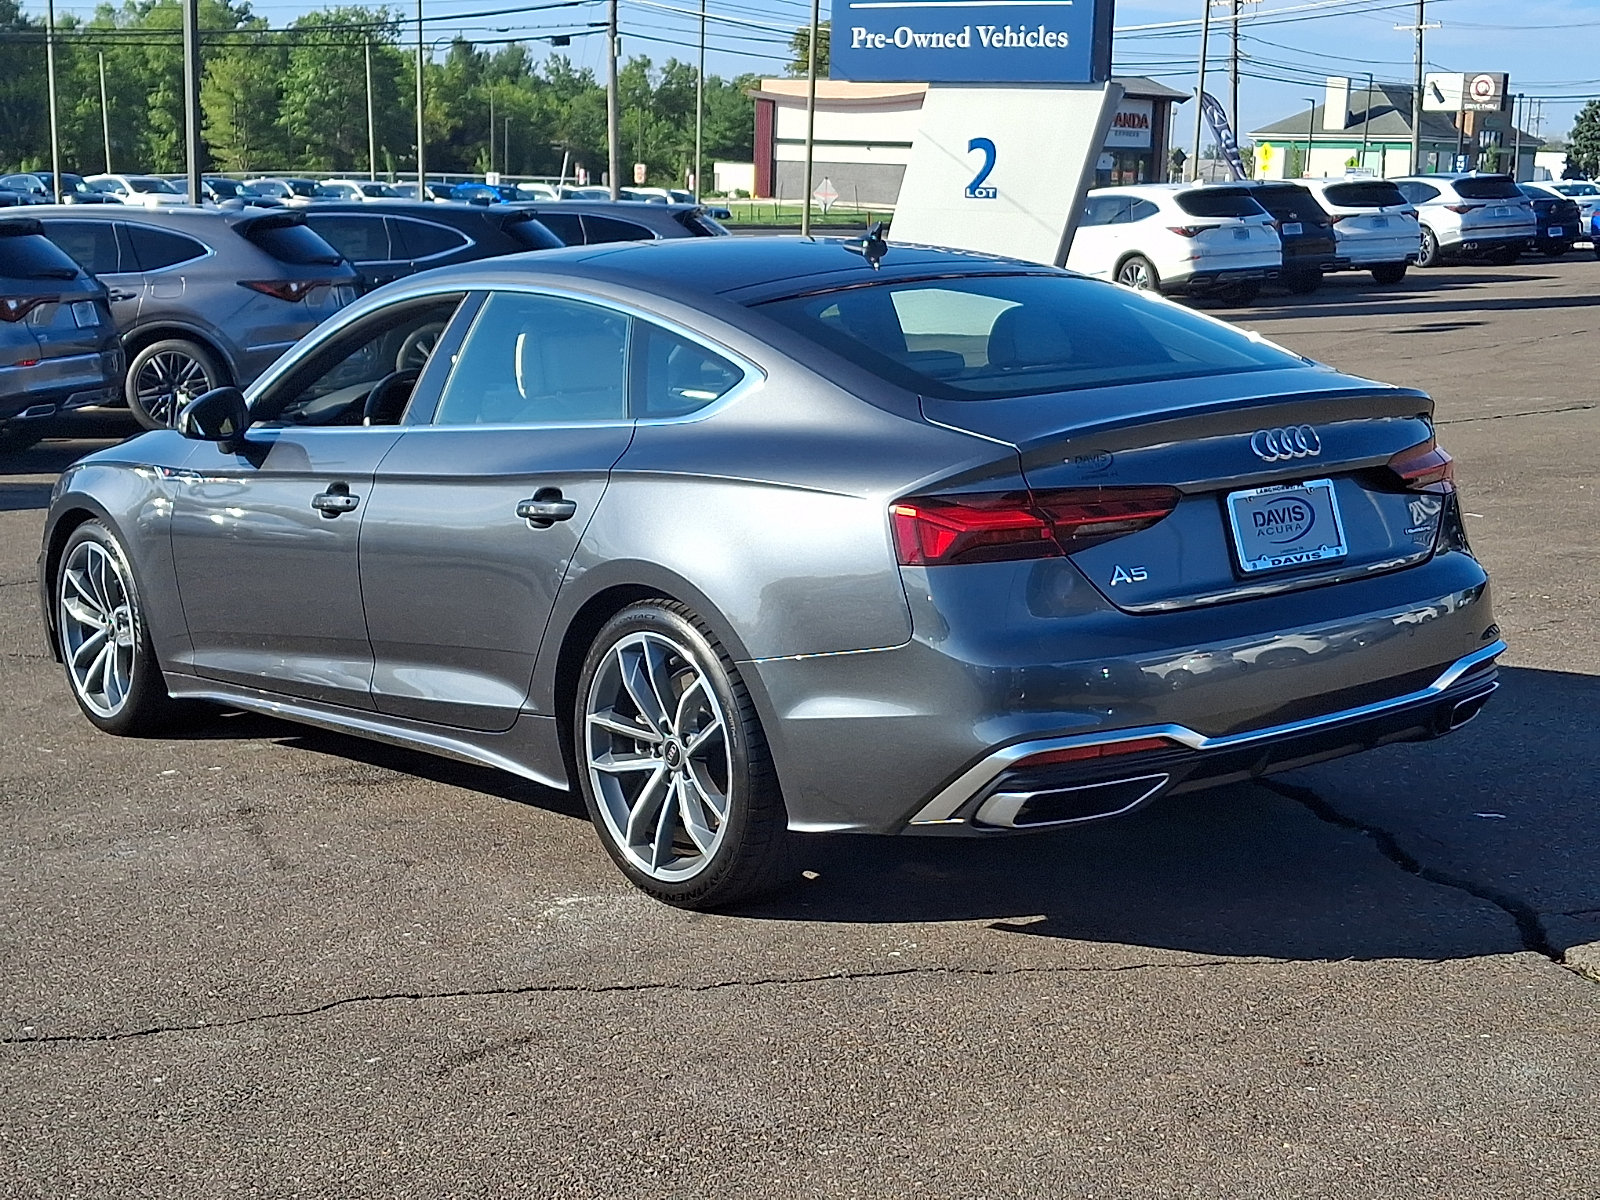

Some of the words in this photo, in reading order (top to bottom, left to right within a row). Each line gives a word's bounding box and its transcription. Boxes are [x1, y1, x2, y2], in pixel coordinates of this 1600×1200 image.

[851, 26, 970, 49] Pre-Owned
[975, 25, 1069, 48] Vehicles
[1112, 112, 1149, 129] ANDA
[966, 136, 997, 190] 2
[965, 187, 997, 199] LOT
[1252, 505, 1305, 528] DAVIS
[1256, 523, 1303, 537] ACURA
[1270, 551, 1323, 566] DAVIS
[1110, 564, 1149, 586] A5
